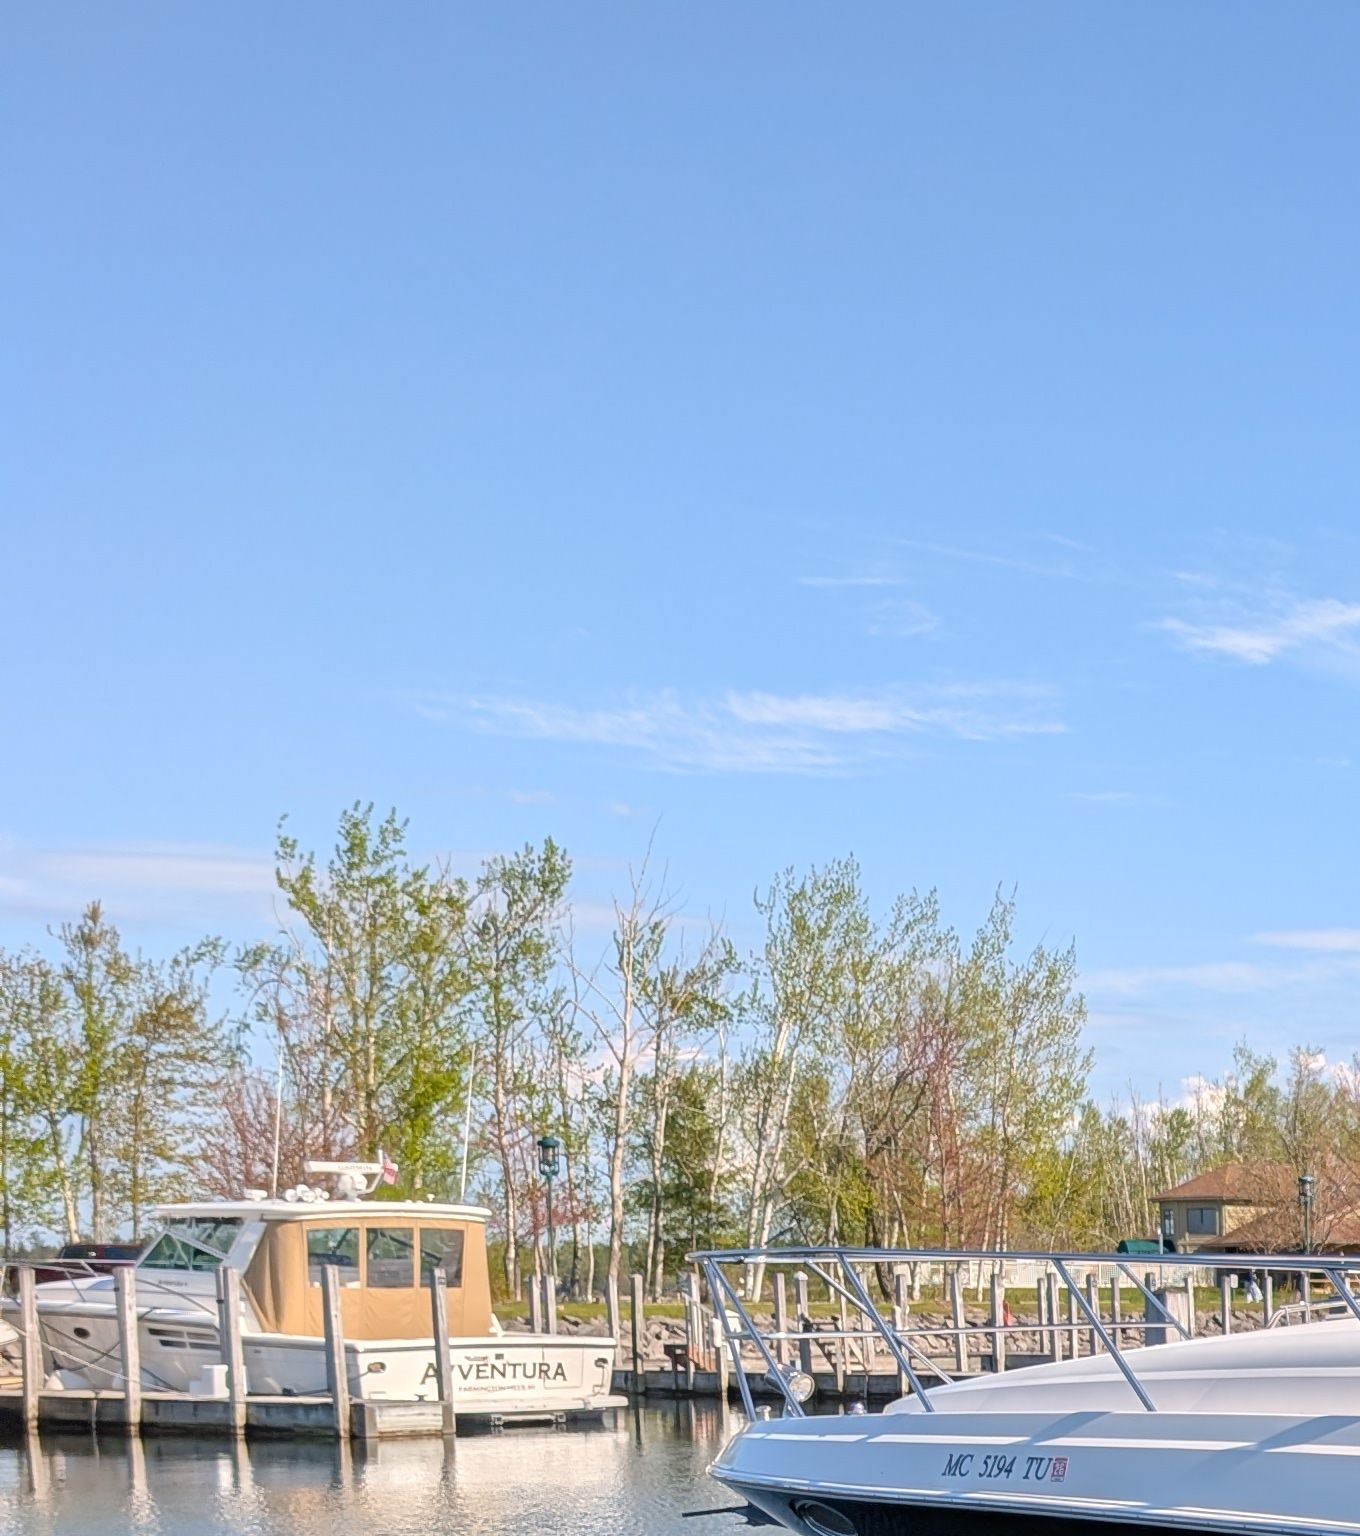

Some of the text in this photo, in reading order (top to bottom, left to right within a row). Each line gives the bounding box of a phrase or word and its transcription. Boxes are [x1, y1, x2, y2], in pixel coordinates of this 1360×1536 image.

[420, 1362, 568, 1385] AVENTURA
[941, 1454, 1054, 1480] MC 5194 TU
